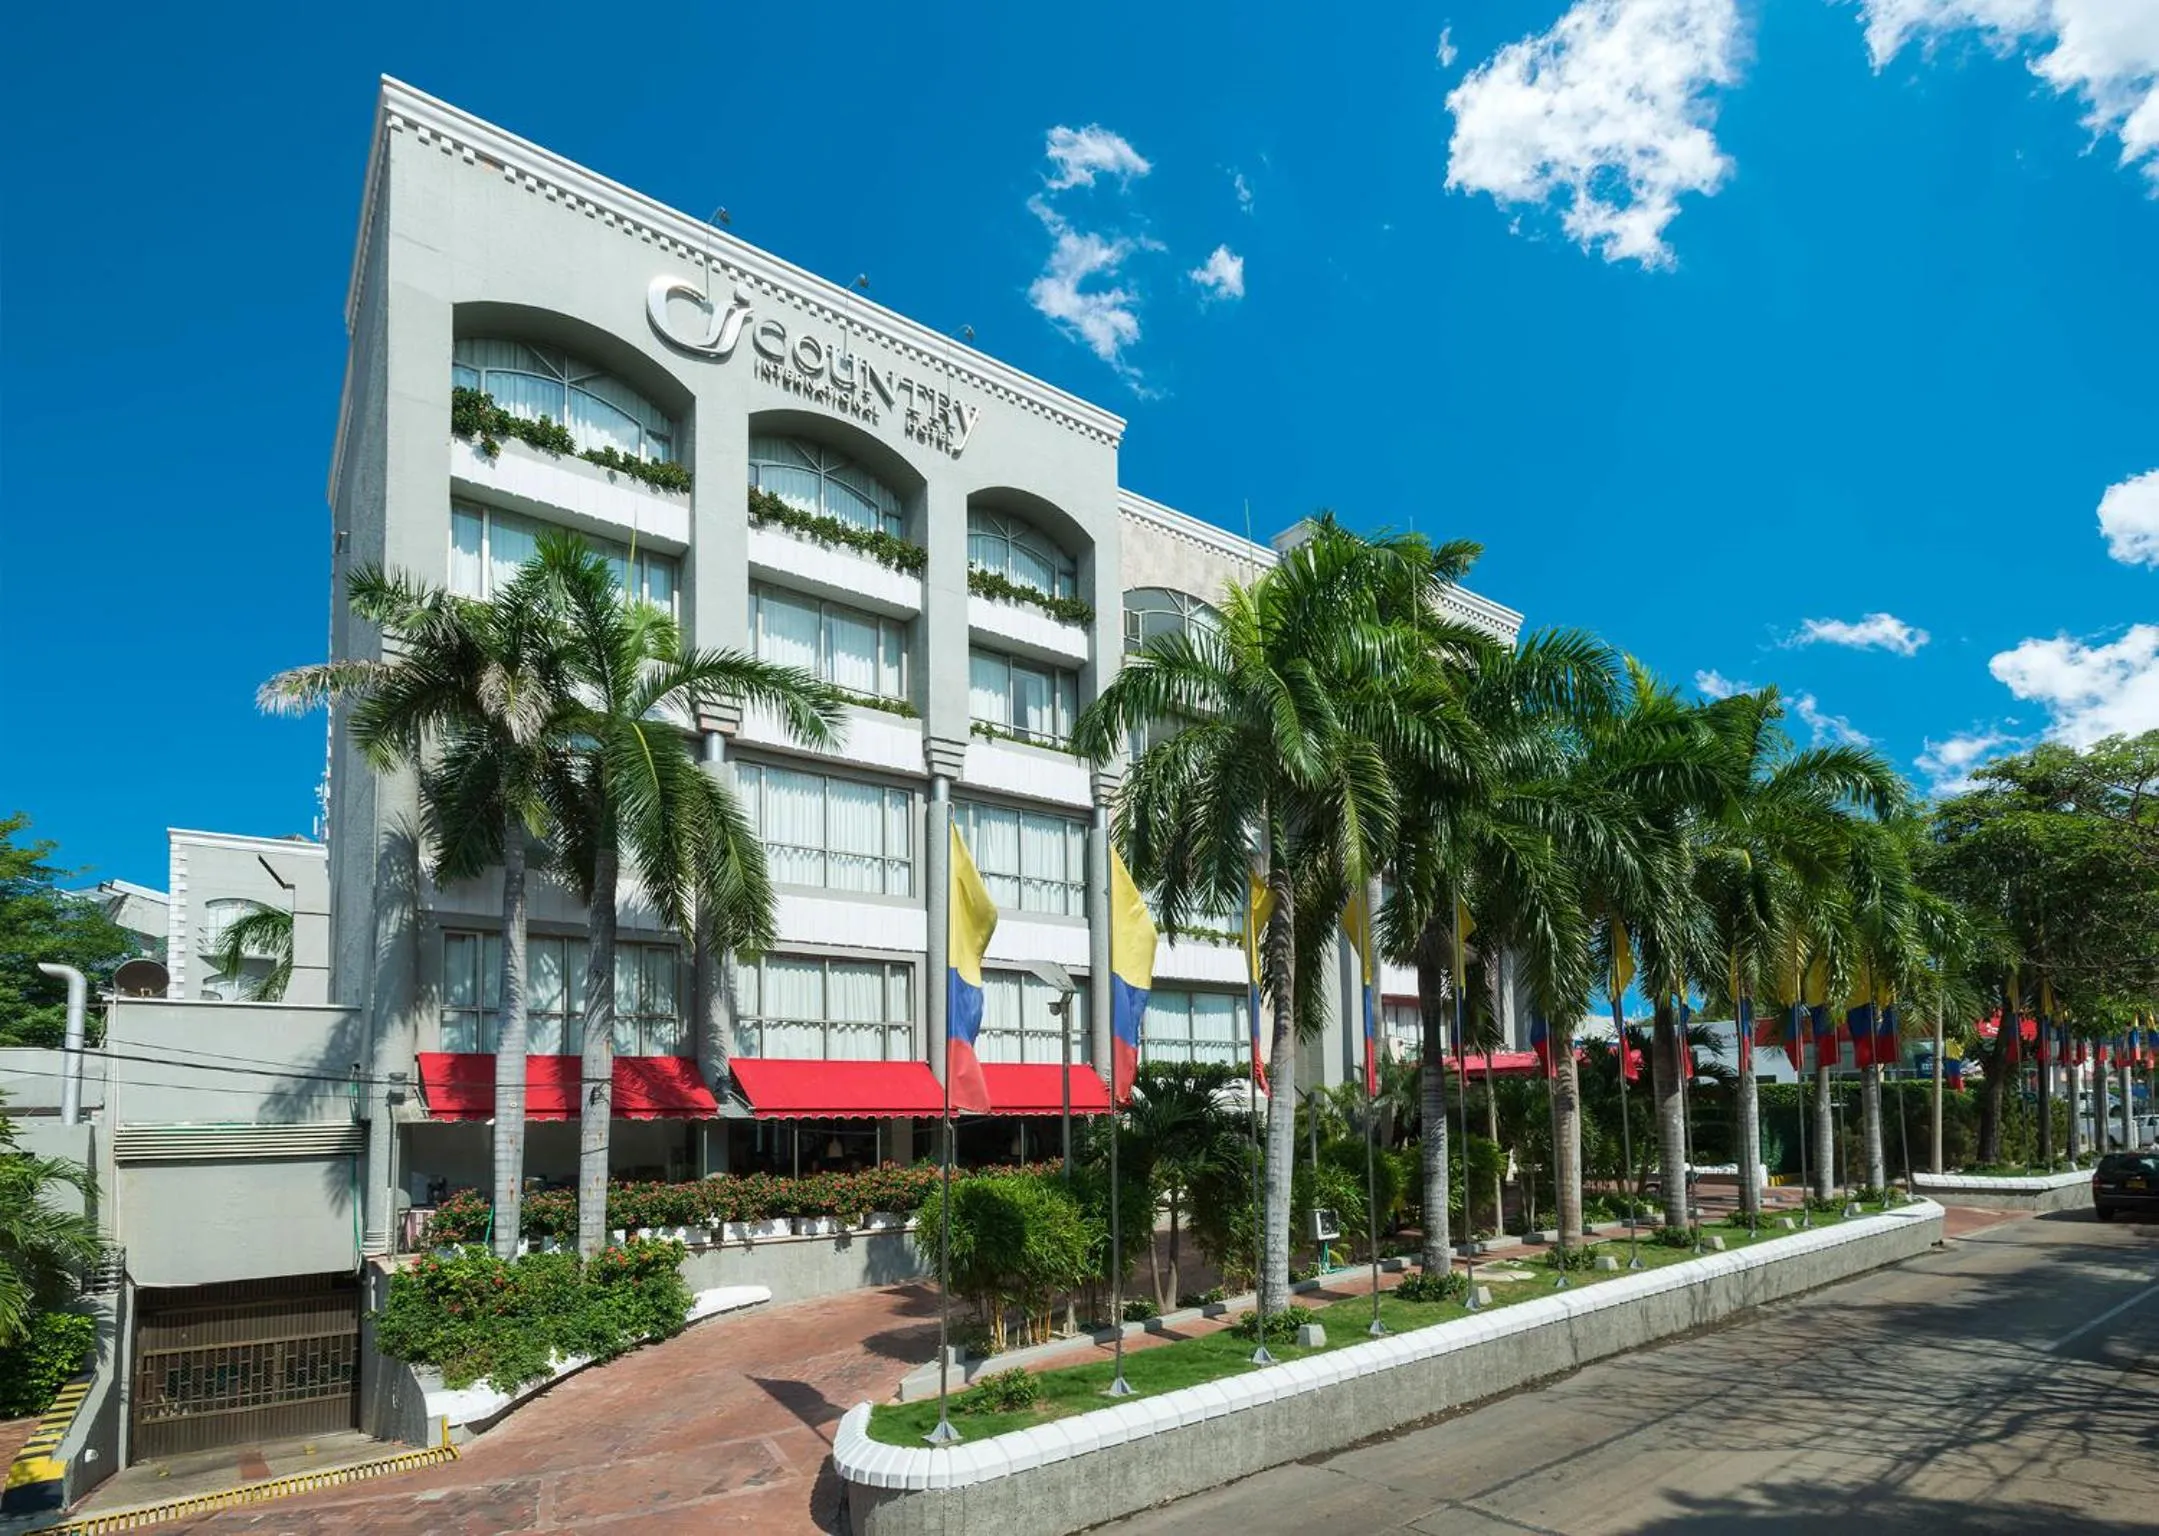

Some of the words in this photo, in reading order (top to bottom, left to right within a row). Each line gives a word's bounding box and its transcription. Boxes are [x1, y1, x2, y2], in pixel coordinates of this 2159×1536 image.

[752, 319, 980, 454] COUNTRY
[755, 358, 880, 425] INTERNATIONAL
[905, 421, 954, 454] HOTEL
